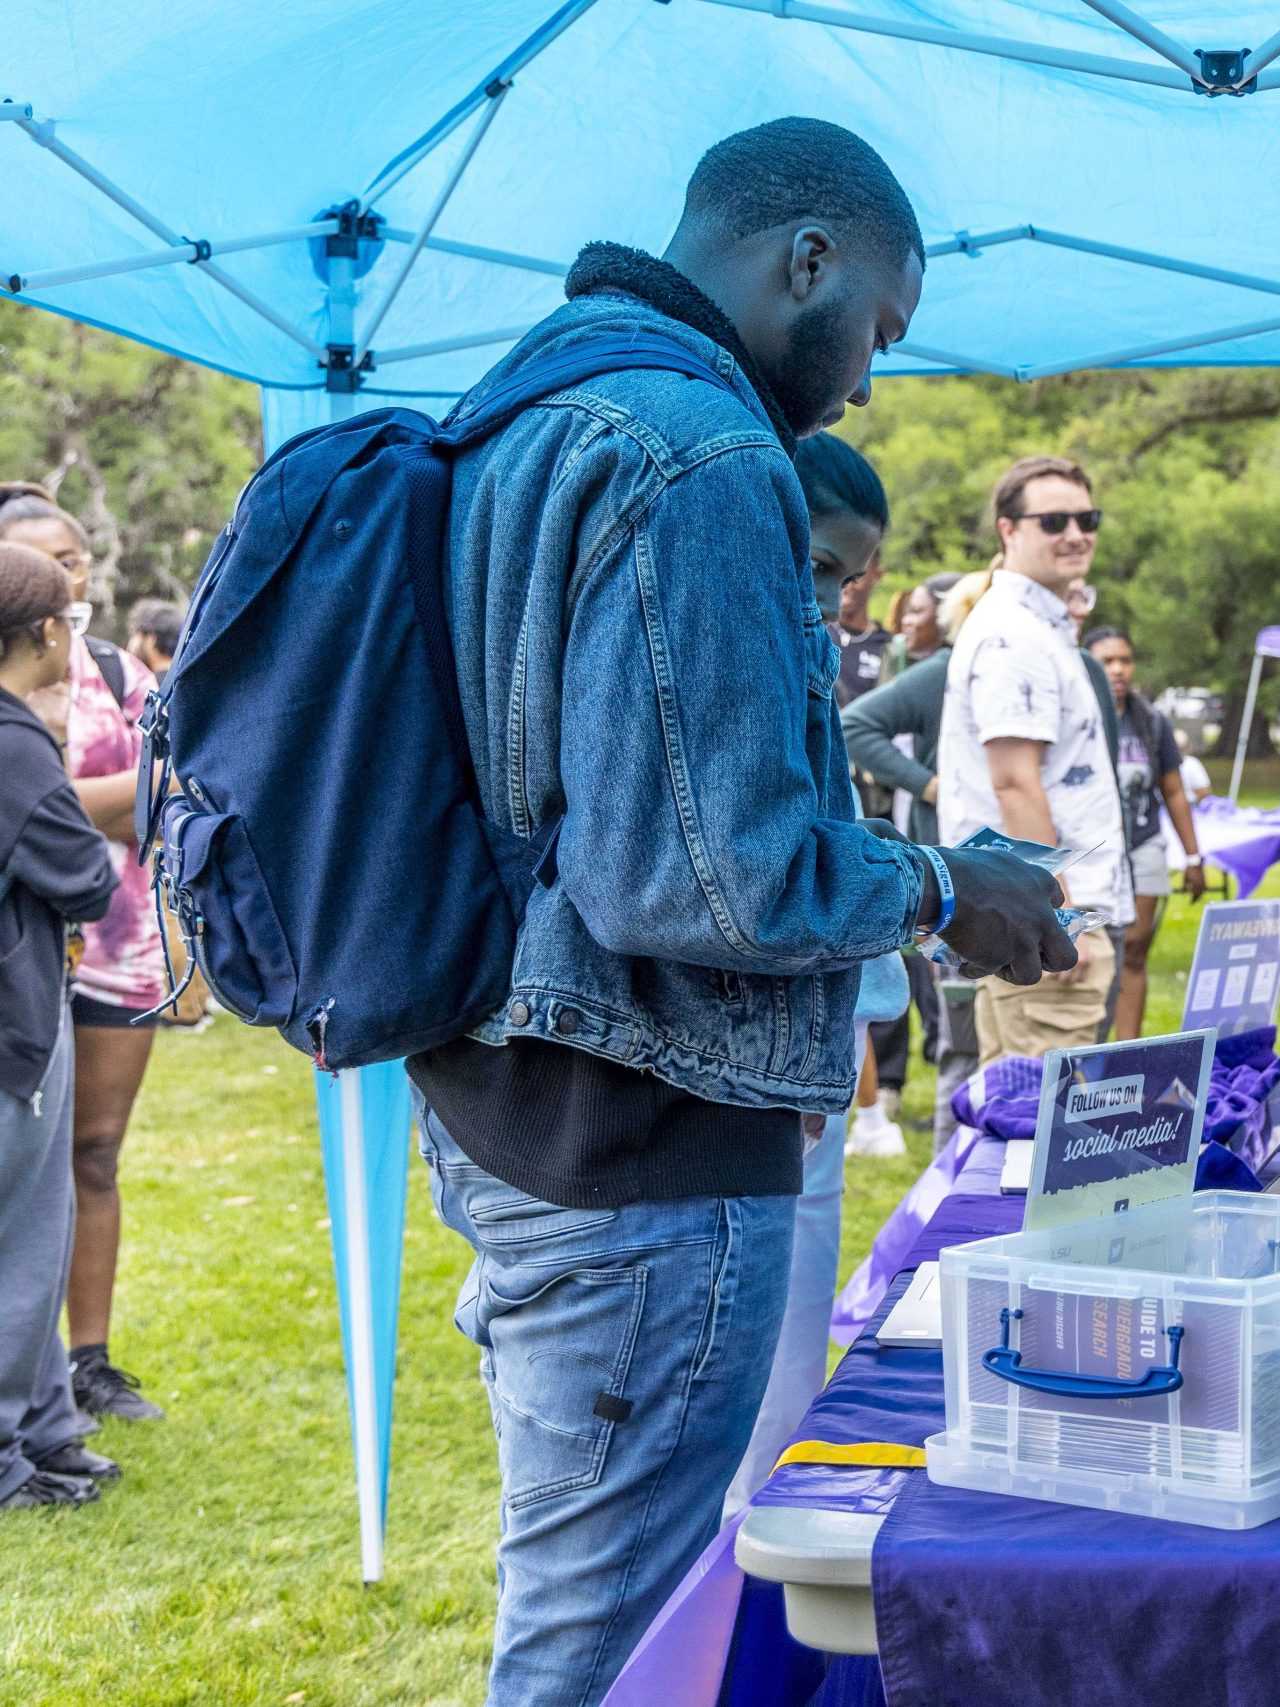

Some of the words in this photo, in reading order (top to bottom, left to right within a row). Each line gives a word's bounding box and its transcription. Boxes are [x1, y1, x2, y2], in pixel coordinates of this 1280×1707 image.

[937, 863, 951, 894] Sigma
[1070, 1090, 1107, 1114] FOLLOW
[1109, 1089, 1122, 1107] US
[1123, 1084, 1138, 1105] ON
[1063, 1125, 1119, 1162] social
[1117, 1112, 1183, 1151] media!
[1092, 1298, 1108, 1358] SEARCH
[1140, 1298, 1157, 1335] UIDE
[1140, 1338, 1156, 1358] TO
